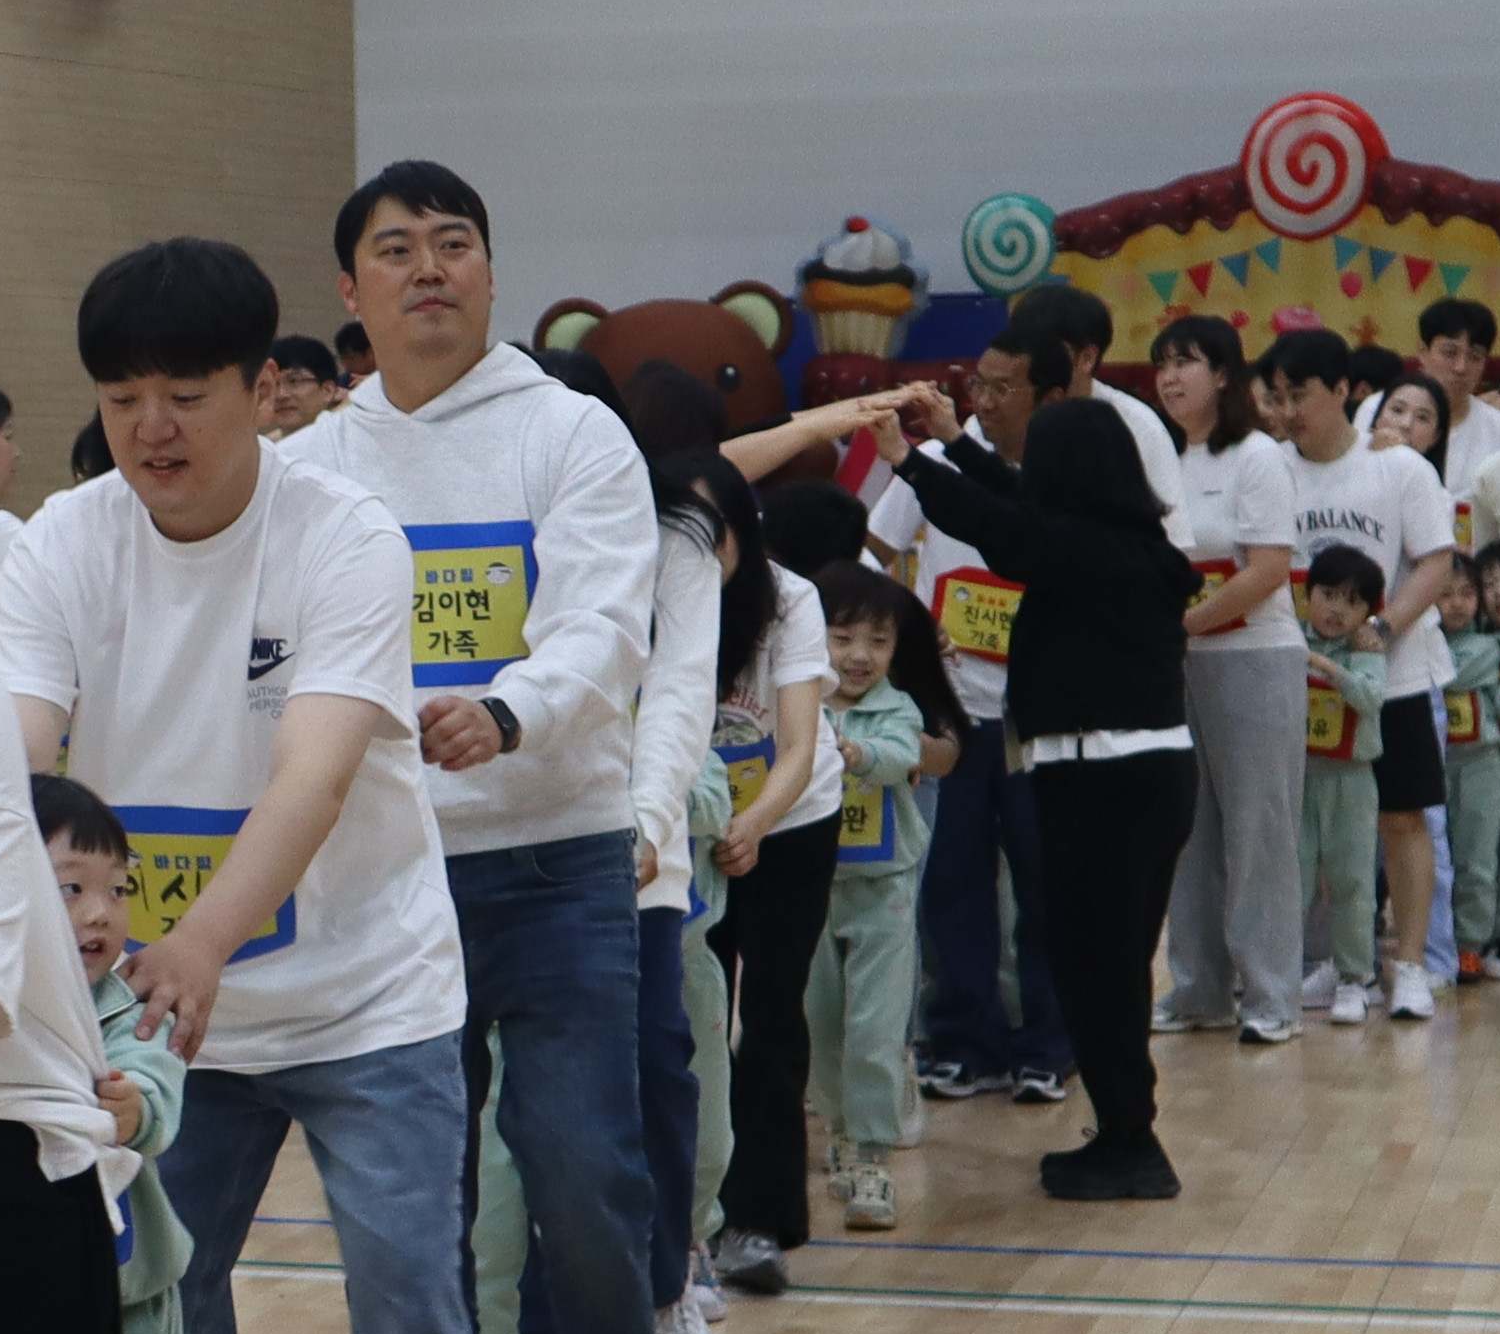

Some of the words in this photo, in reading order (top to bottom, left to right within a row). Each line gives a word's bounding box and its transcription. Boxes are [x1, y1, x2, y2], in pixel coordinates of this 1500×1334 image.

[1307, 508, 1386, 545] BALANCE
[411, 588, 492, 624] 김이현
[250, 637, 289, 661] NIKE
[427, 629, 480, 659] 가족
